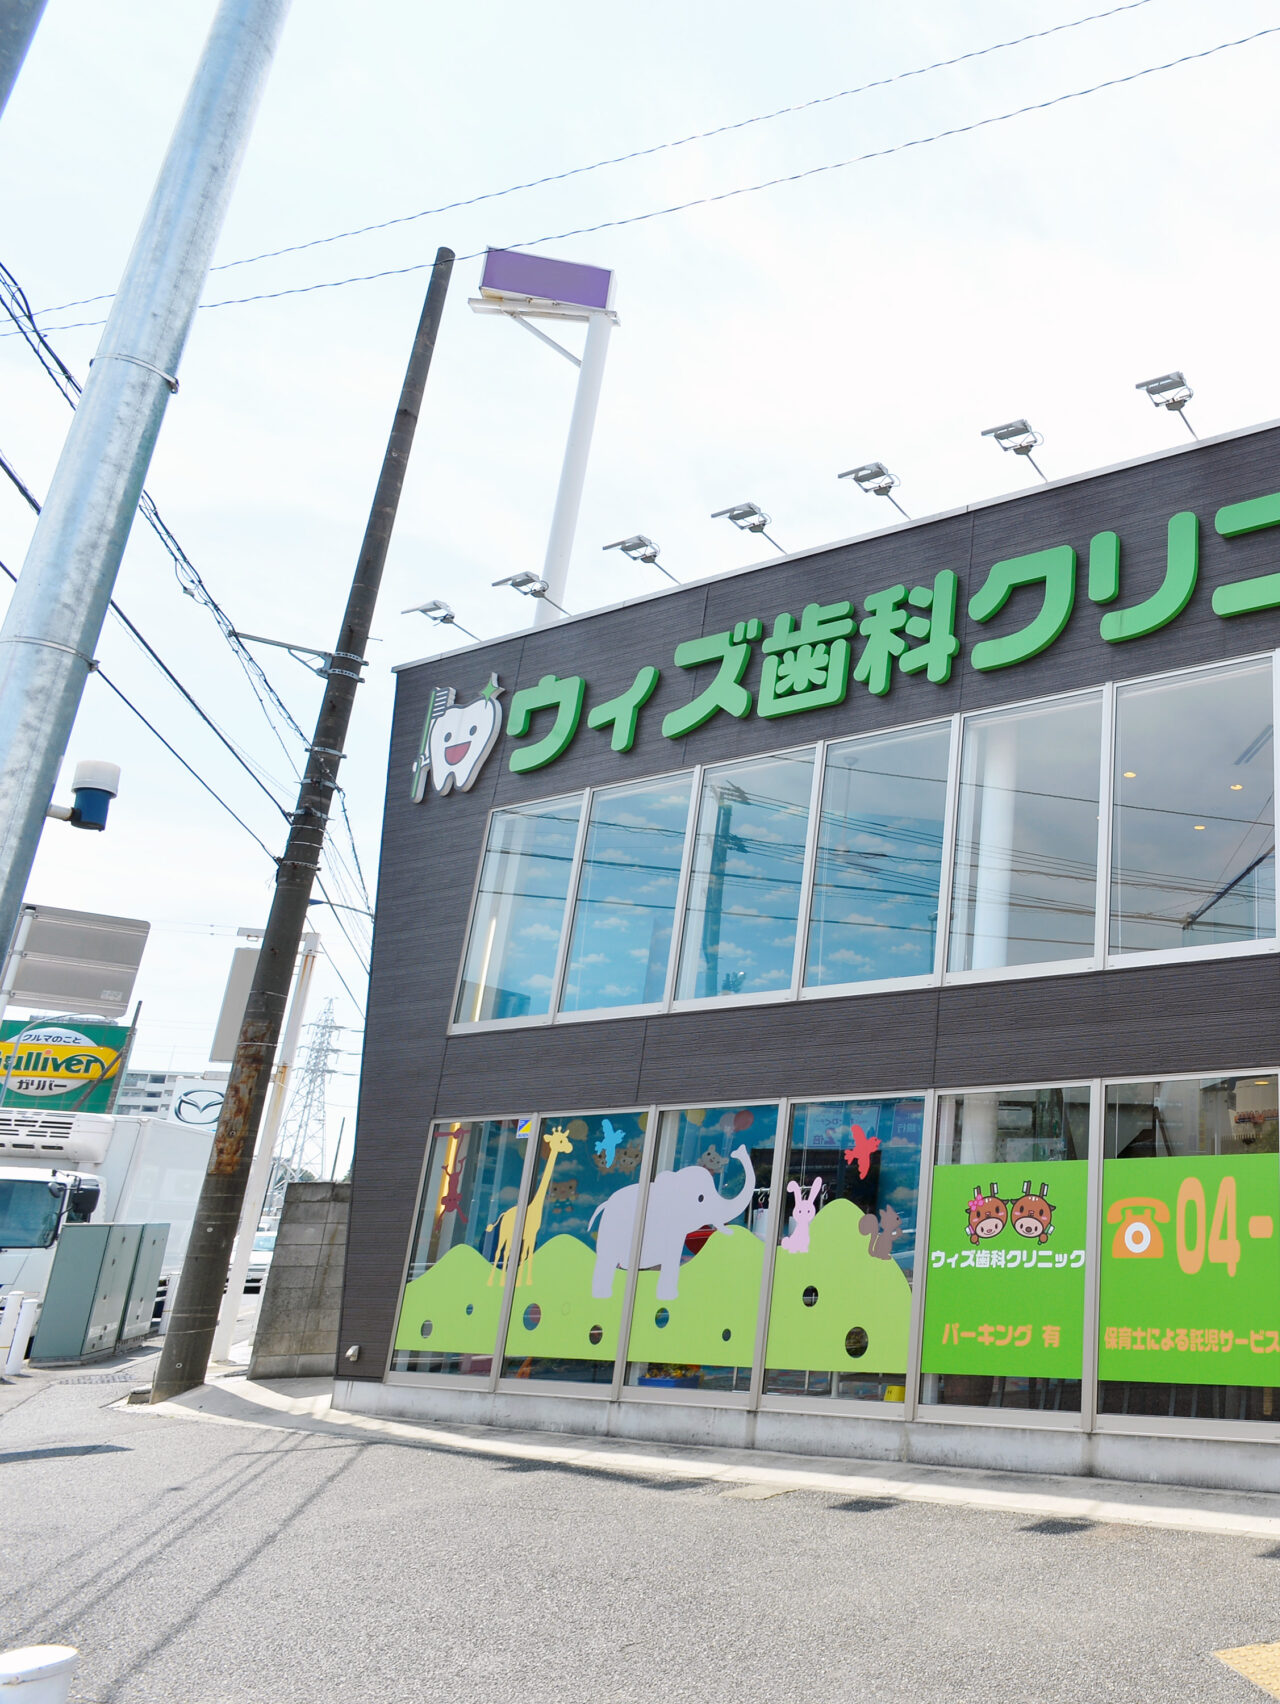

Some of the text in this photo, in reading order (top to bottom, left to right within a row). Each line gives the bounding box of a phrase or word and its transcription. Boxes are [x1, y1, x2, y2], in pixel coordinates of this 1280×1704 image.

[23, 1033, 82, 1044] クルマのこと
[0, 1049, 106, 1074] ulliver
[17, 1079, 68, 1091] ガリバー
[931, 1249, 1086, 1269] ウィズ歯科クリニック
[942, 1322, 1061, 1348] パーキング 有
[1103, 1326, 1280, 1354] 保育士による託児サービス
